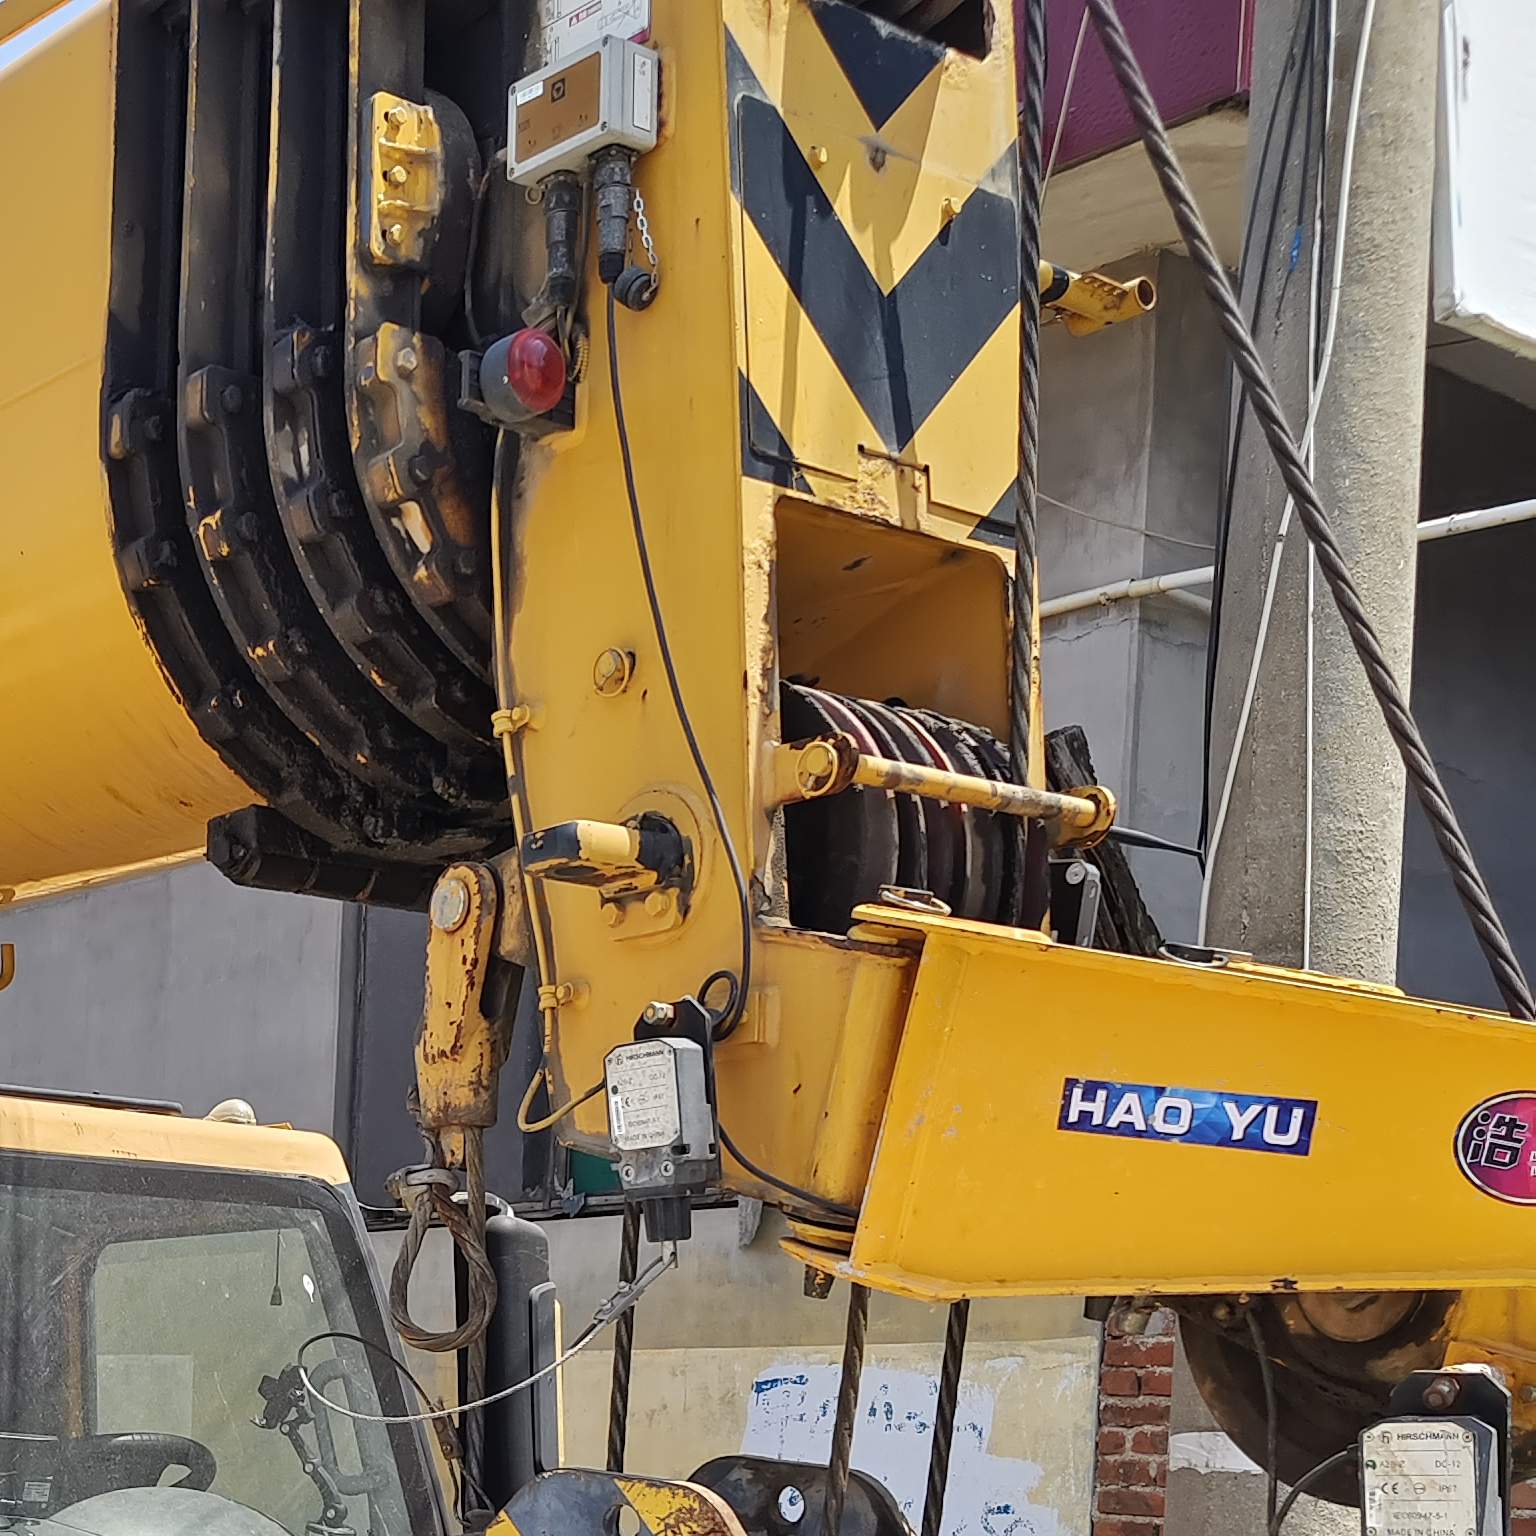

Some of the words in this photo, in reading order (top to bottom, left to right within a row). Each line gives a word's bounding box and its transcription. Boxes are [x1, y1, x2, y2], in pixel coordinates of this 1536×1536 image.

[1067, 1087, 1193, 1135] HAO
[1222, 1101, 1305, 1146] YU
[1396, 1432, 1459, 1441] HIRSCHMANN
[1387, 1529, 1412, 1536] MADE
[1426, 1529, 1456, 1536] CHINA
